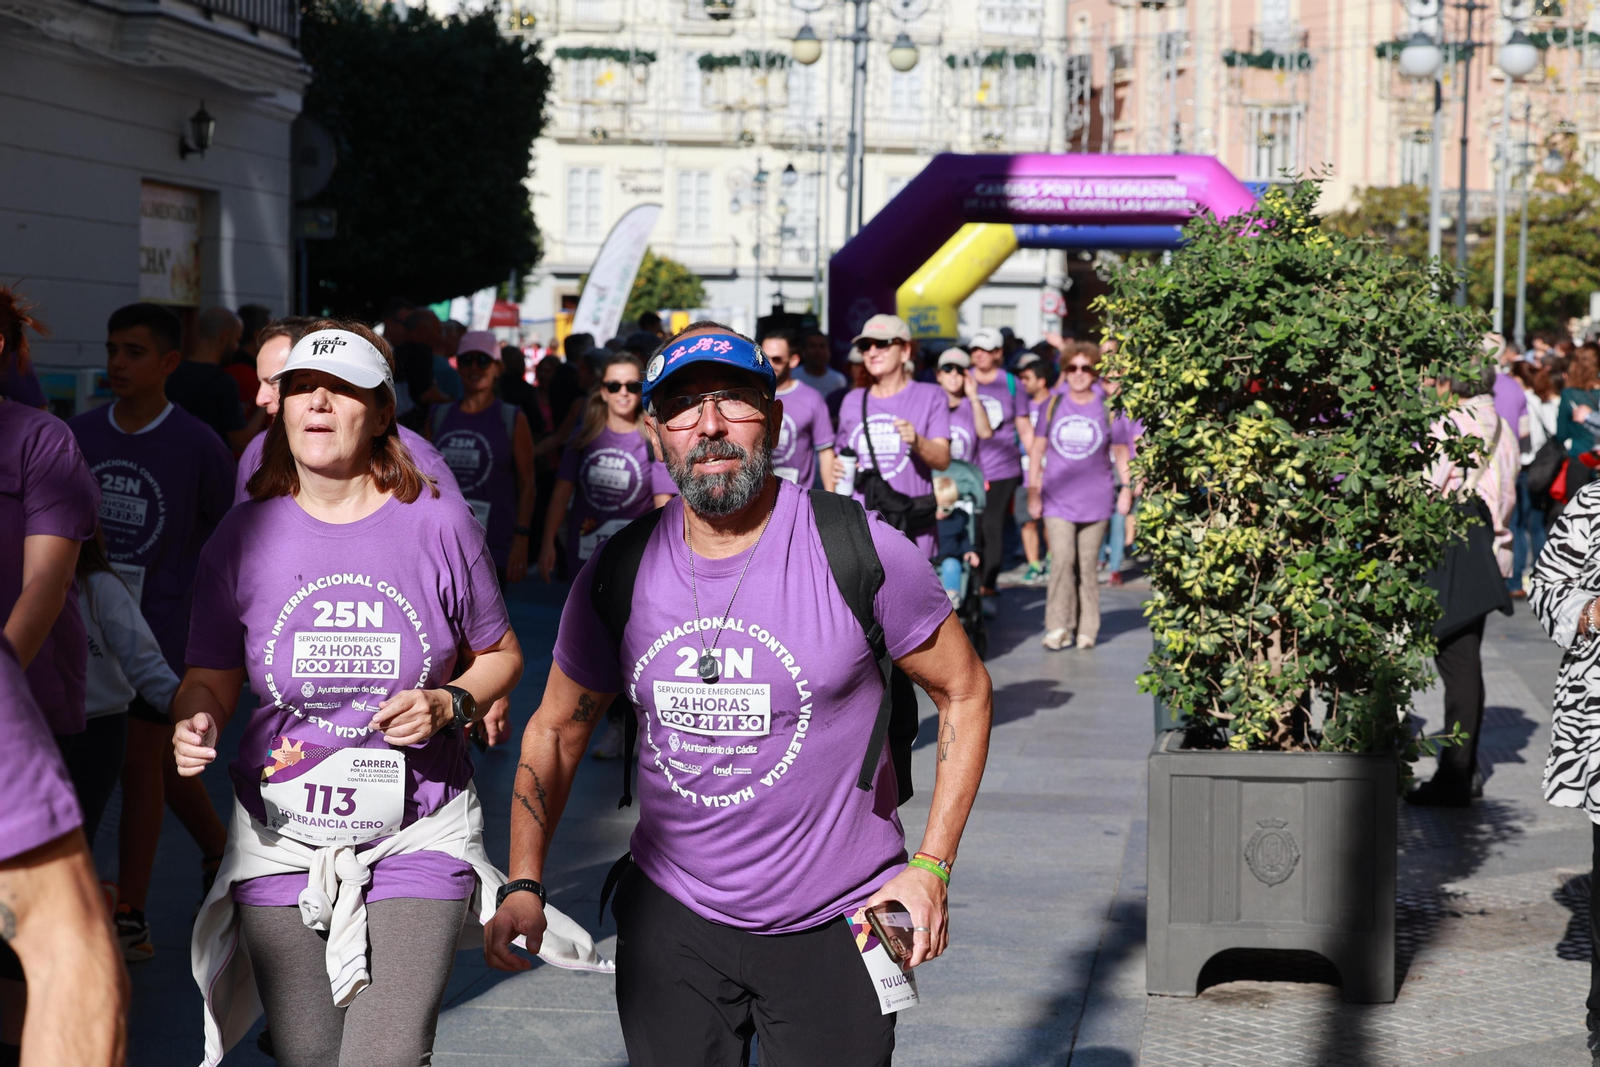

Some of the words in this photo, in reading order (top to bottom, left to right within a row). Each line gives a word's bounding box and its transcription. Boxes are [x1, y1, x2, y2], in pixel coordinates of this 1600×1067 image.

[1041, 182, 1074, 198] POR
[1074, 182, 1094, 198] LA
[1120, 197, 1141, 212] LAS
[311, 343, 336, 356] TRI
[447, 436, 476, 449] 25N
[597, 454, 627, 471] 25N
[101, 473, 142, 496] 25N
[138, 466, 164, 501] CONTRA
[157, 500, 167, 515] LA
[271, 573, 373, 637] INTERNACIONAL
[312, 600, 384, 628] 25N
[376, 580, 423, 632] CONTRA
[298, 635, 332, 643] SERVICIO
[333, 635, 343, 643] DE
[344, 635, 397, 644] EMERGENCIAS
[418, 633, 431, 654] LA
[632, 616, 745, 682] INTERNACIONAL
[262, 639, 277, 666] DÍA
[309, 644, 327, 657] 24
[329, 644, 383, 657] HORAS
[748, 624, 802, 681] CONTRA
[297, 659, 331, 674] 900
[334, 660, 349, 674] 21
[352, 660, 368, 674] 21
[371, 660, 393, 674] 30
[317, 685, 361, 695] Ayuntamiento
[361, 685, 370, 694] de
[369, 684, 389, 696] Cádiz
[657, 684, 695, 695] SERVICIO
[695, 687, 706, 695] DE
[707, 687, 766, 696] EMERGENCIAS
[795, 679, 812, 702] LA
[351, 699, 366, 712] imd
[669, 696, 689, 710] 24
[692, 697, 750, 712] HORAS
[307, 715, 335, 734] LAS
[661, 711, 695, 728] 900
[698, 715, 714, 730] 21
[717, 715, 734, 731] 21
[737, 715, 762, 731] 30
[681, 740, 724, 755] Ayuntamiento
[725, 746, 735, 756] de
[735, 744, 758, 755] Cádiz
[759, 702, 813, 788] VIOLENCIA
[352, 758, 400, 769] CARRERA
[713, 763, 733, 777] imd
[303, 782, 358, 817] 113
[671, 781, 697, 804] LAS
[700, 785, 756, 808] HACIA
[279, 807, 348, 830] TOLERANCIA
[351, 820, 384, 830] CERO
[880, 976, 893, 990] TU
